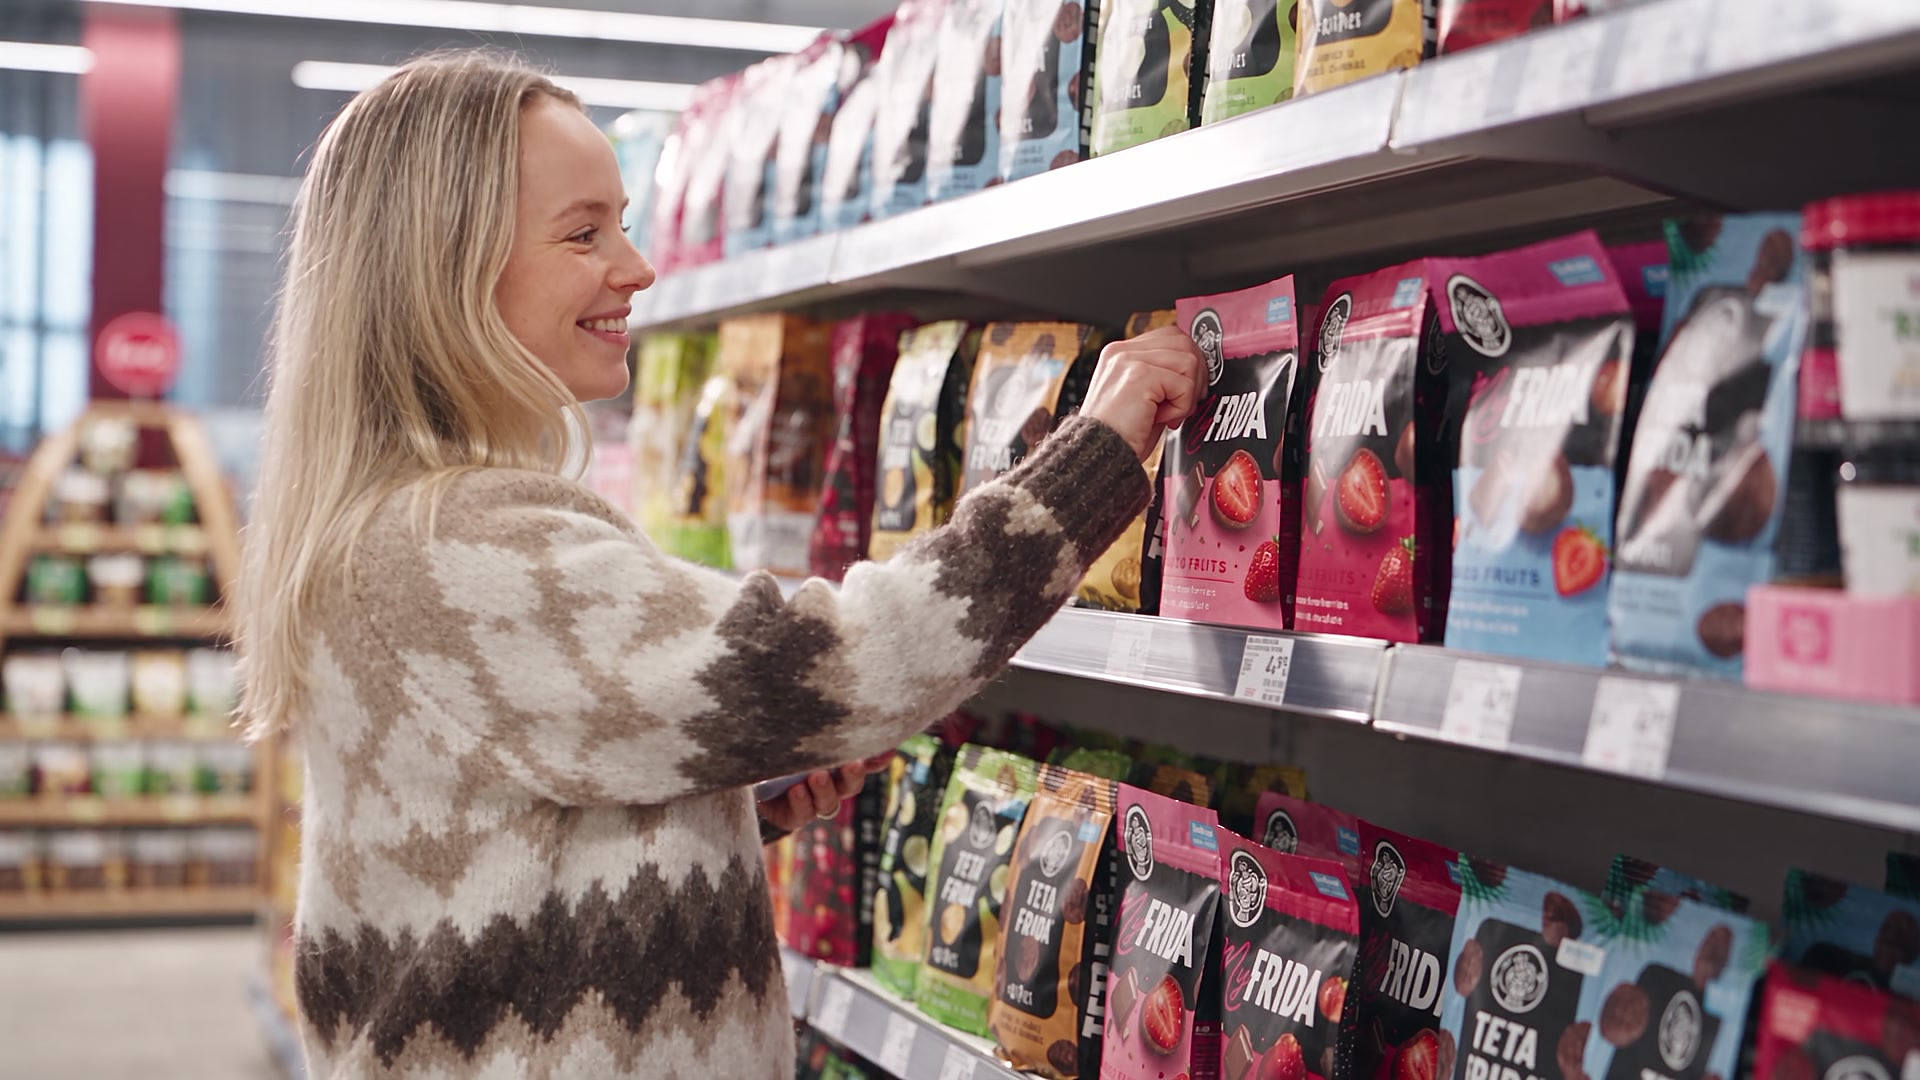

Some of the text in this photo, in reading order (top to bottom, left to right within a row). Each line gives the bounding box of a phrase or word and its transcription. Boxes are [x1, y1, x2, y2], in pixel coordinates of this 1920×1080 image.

[1203, 389, 1267, 442] FRIDA
[1318, 377, 1388, 438] FRIDA
[1501, 361, 1593, 428] FRIDA
[1189, 557, 1227, 574] FRUITS
[1026, 879, 1057, 914] TETA
[1135, 898, 1196, 968] FRIDA
[1221, 936, 1322, 1028] My FRIDA
[1472, 1009, 1538, 1071] TETA
